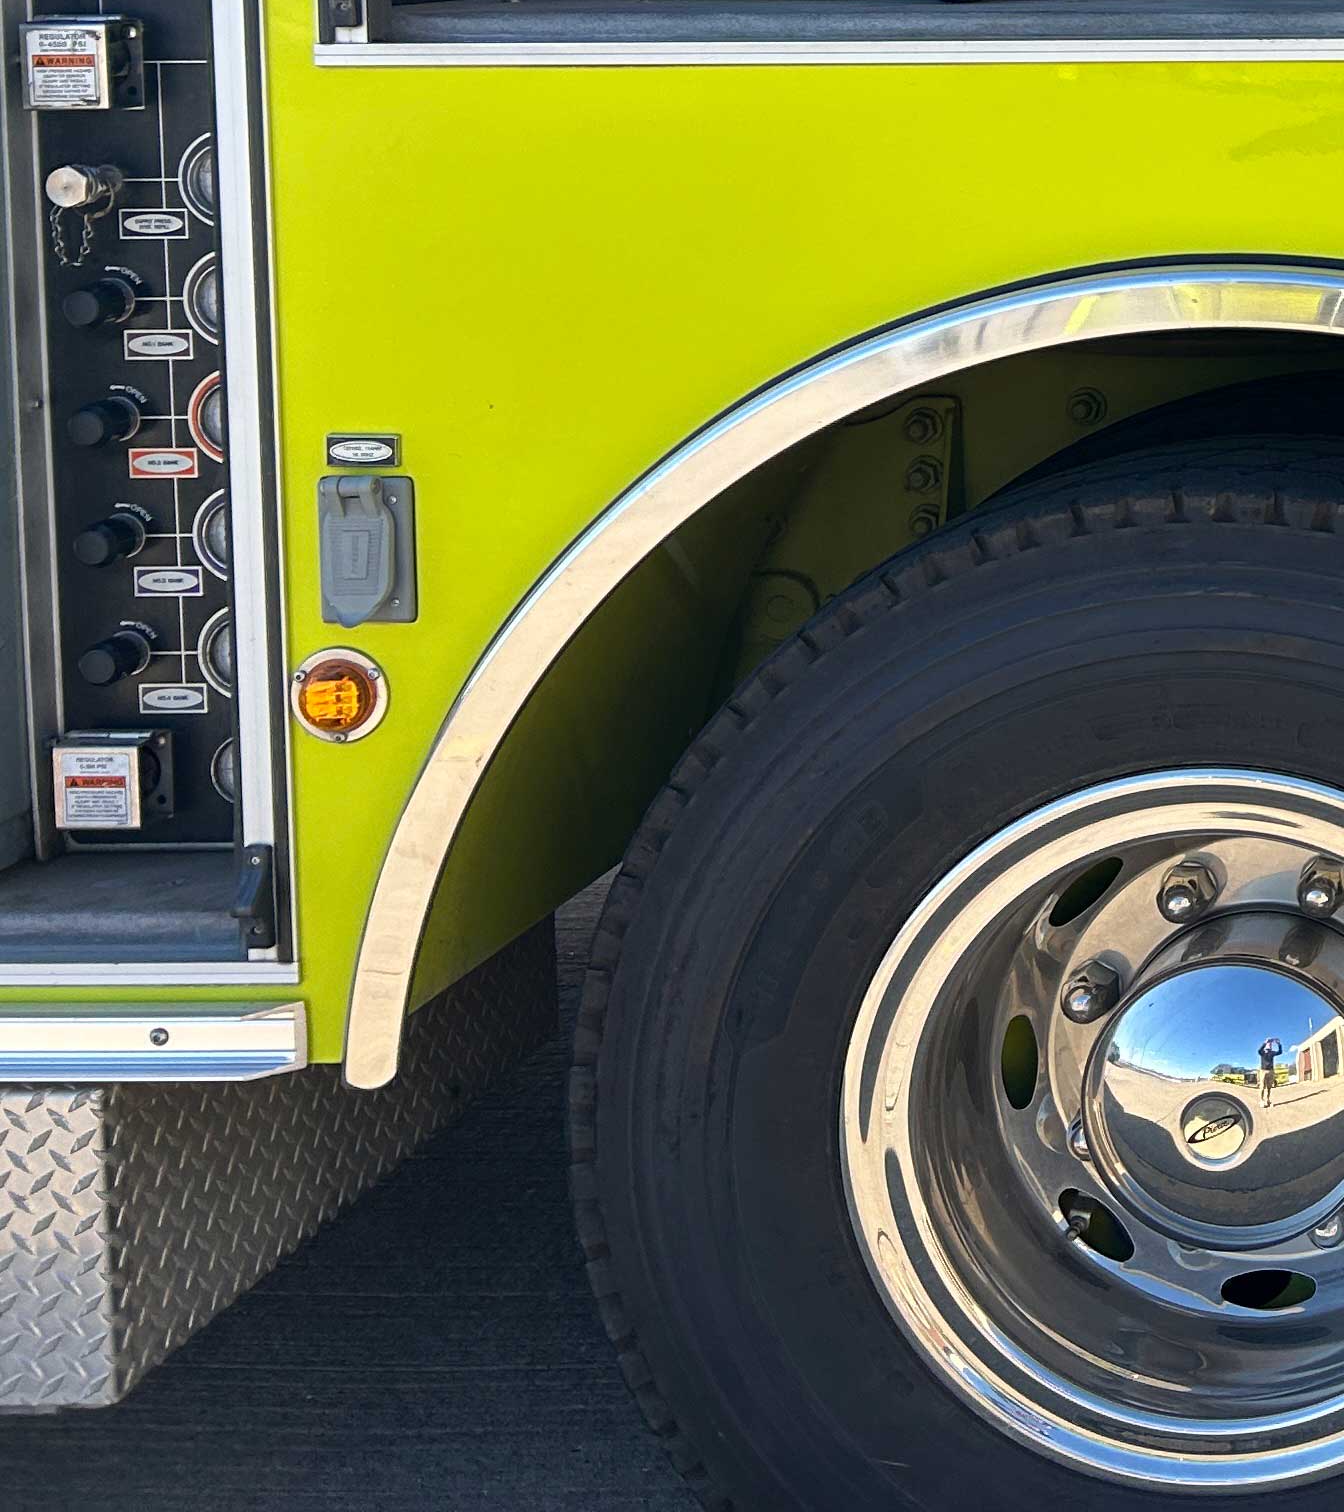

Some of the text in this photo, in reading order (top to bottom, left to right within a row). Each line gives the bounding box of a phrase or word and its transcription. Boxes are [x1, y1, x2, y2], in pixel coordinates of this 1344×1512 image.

[120, 267, 143, 285] OPEN
[126, 385, 148, 404] OPEN
[130, 503, 152, 522] OPEN
[136, 621, 158, 640] OPEN
